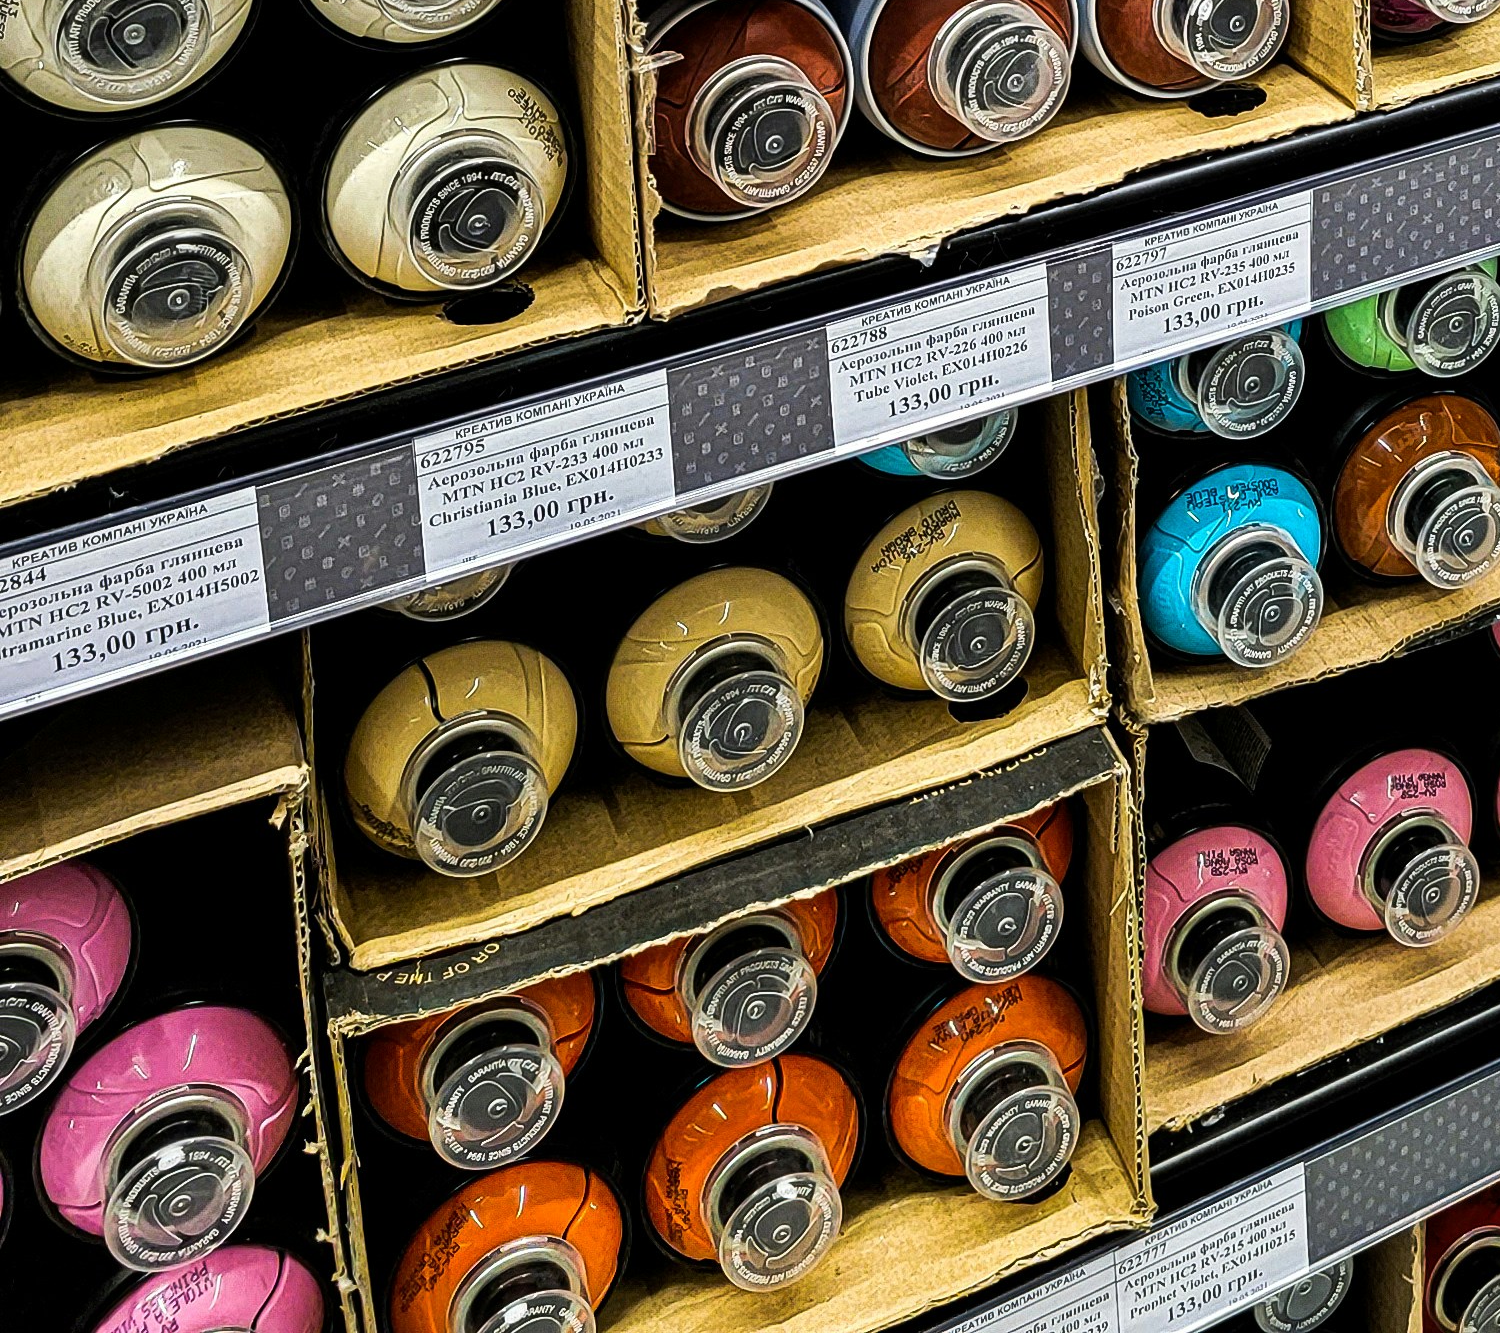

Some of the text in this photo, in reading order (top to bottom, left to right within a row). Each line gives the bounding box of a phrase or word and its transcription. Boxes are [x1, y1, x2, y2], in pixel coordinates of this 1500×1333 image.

[421, 172, 482, 241] PRODUCTS SINCE 1994
[1115, 245, 1167, 272] 622797
[861, 304, 912, 327] КРЕАТИВ
[914, 289, 963, 311] КОМПАНІ
[1163, 295, 1264, 334] 133,00 грн.
[830, 326, 888, 354] 622788
[837, 306, 1036, 374] Аерозольна фарба глянцева
[926, 337, 977, 364] RV-226
[980, 330, 1004, 347] 400
[1007, 326, 1026, 340] мл
[853, 339, 1028, 403] Tube Violet, EX014H0226
[888, 374, 1000, 418] 133,00 грн.
[455, 415, 513, 440] КРЕАТИВ
[515, 397, 572, 423] КОМПАНІ
[418, 436, 486, 469] 622795
[427, 416, 655, 491] Аерозольна фарба глянцева
[530, 451, 588, 480] RV-233
[592, 442, 619, 460] 400
[623, 437, 644, 452] мл
[429, 447, 664, 527] Christiania Blue, EX014H0233
[487, 489, 614, 538] 133,00 грн.
